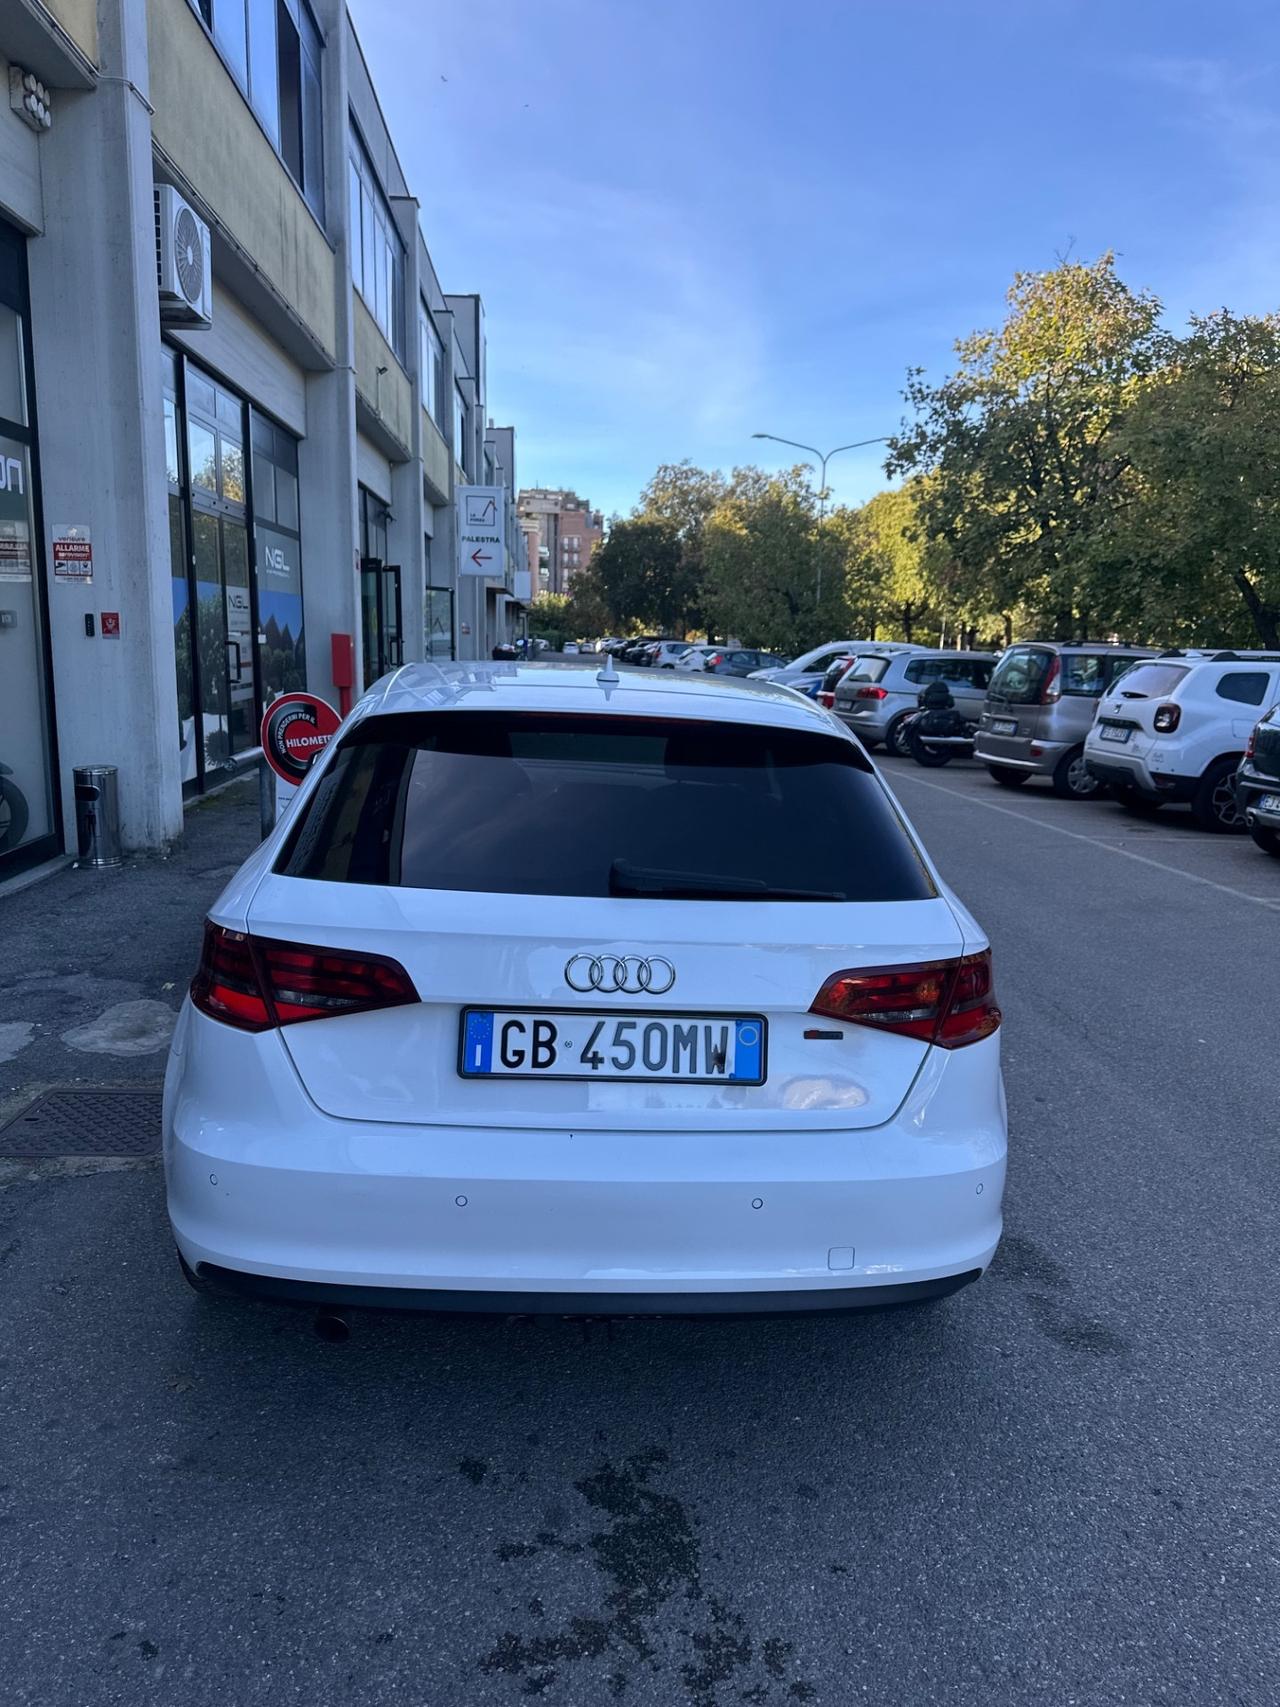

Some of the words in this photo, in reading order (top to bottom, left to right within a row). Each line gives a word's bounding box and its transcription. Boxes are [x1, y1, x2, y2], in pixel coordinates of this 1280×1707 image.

[55, 544, 90, 552] ALLARME
[265, 545, 290, 571] NGL
[500, 1019, 558, 1069] GB
[580, 1021, 728, 1074] 450MW
